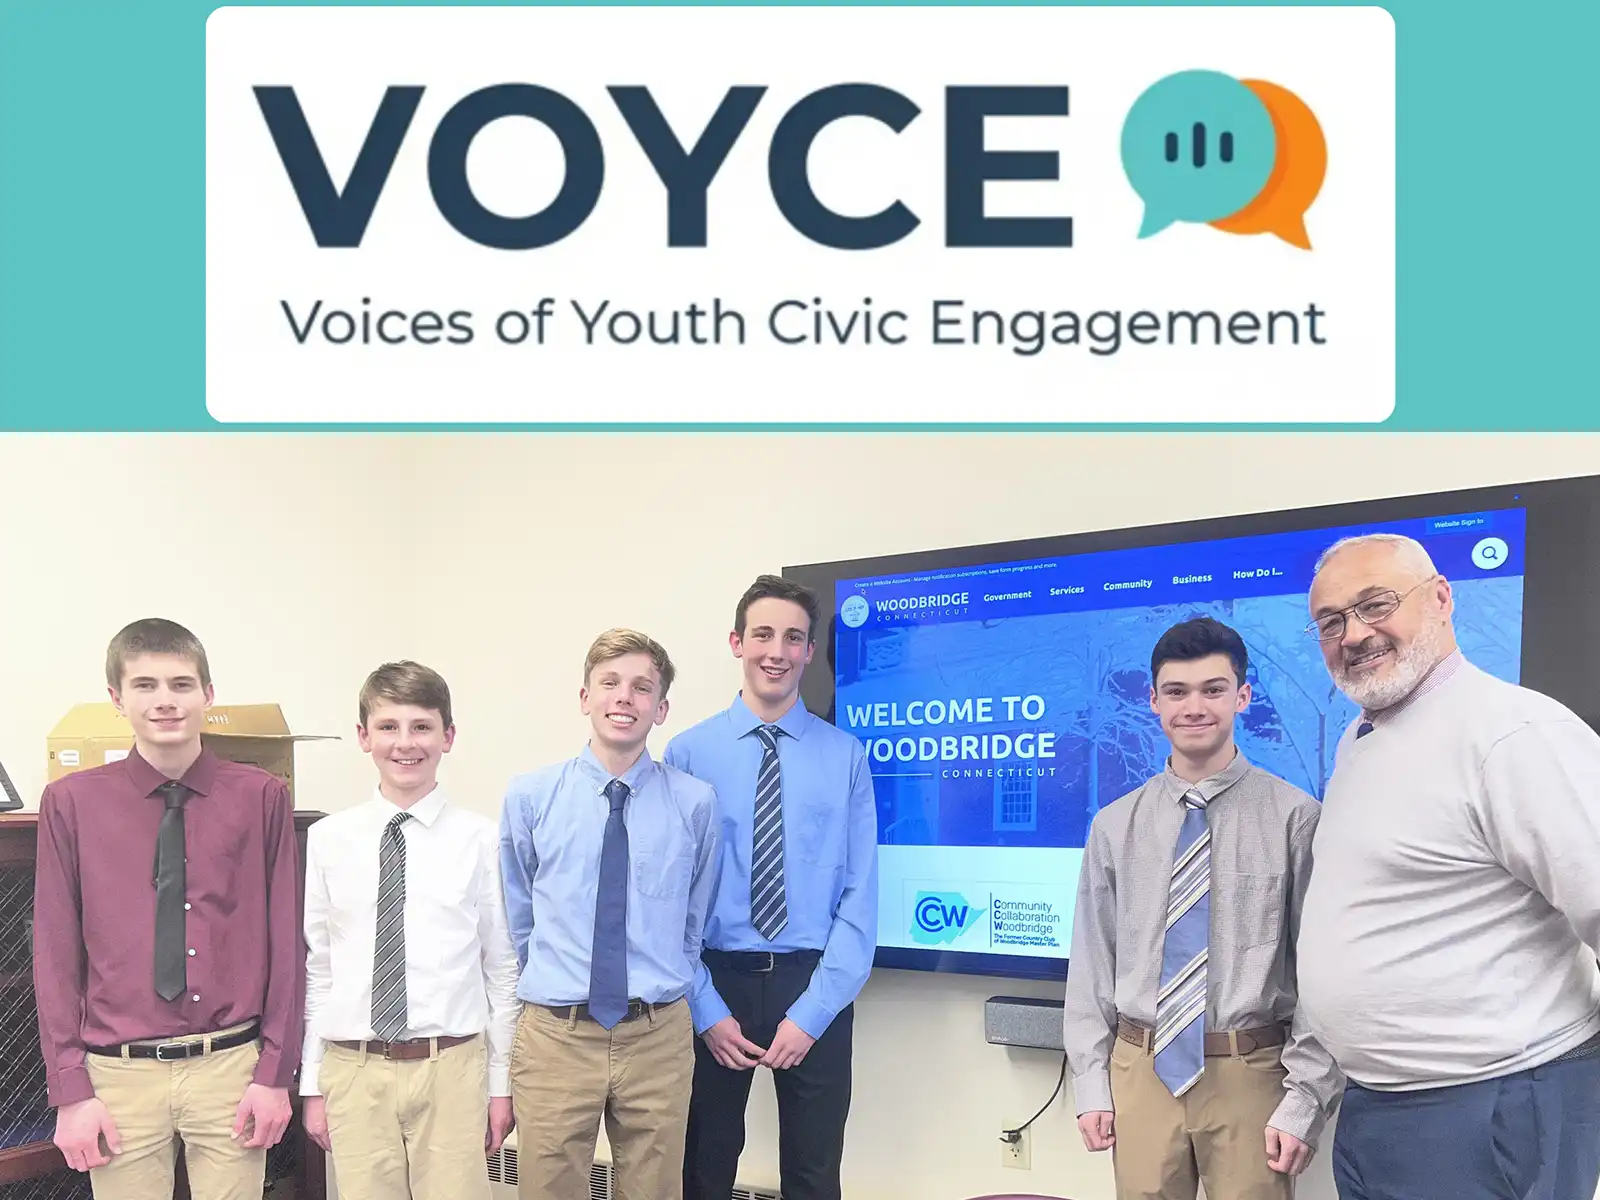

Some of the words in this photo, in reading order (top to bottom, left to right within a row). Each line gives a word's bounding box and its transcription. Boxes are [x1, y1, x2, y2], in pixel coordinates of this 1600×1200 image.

[1172, 573, 1213, 585] Business
[1233, 569, 1254, 580] How
[1256, 568, 1270, 578] Do
[1049, 585, 1085, 596] Services
[1103, 578, 1153, 591] Community
[876, 592, 969, 612] WOODBRIDGE
[983, 590, 1032, 602] Government
[876, 607, 968, 622] CONNECTICUT
[846, 697, 993, 728] WELCOME
[1001, 694, 1046, 721] TO
[942, 767, 1057, 778] CONNECTICUT
[994, 899, 1053, 913] Community
[994, 910, 1060, 923] Collaboration
[994, 921, 1053, 935] Woodbridge
